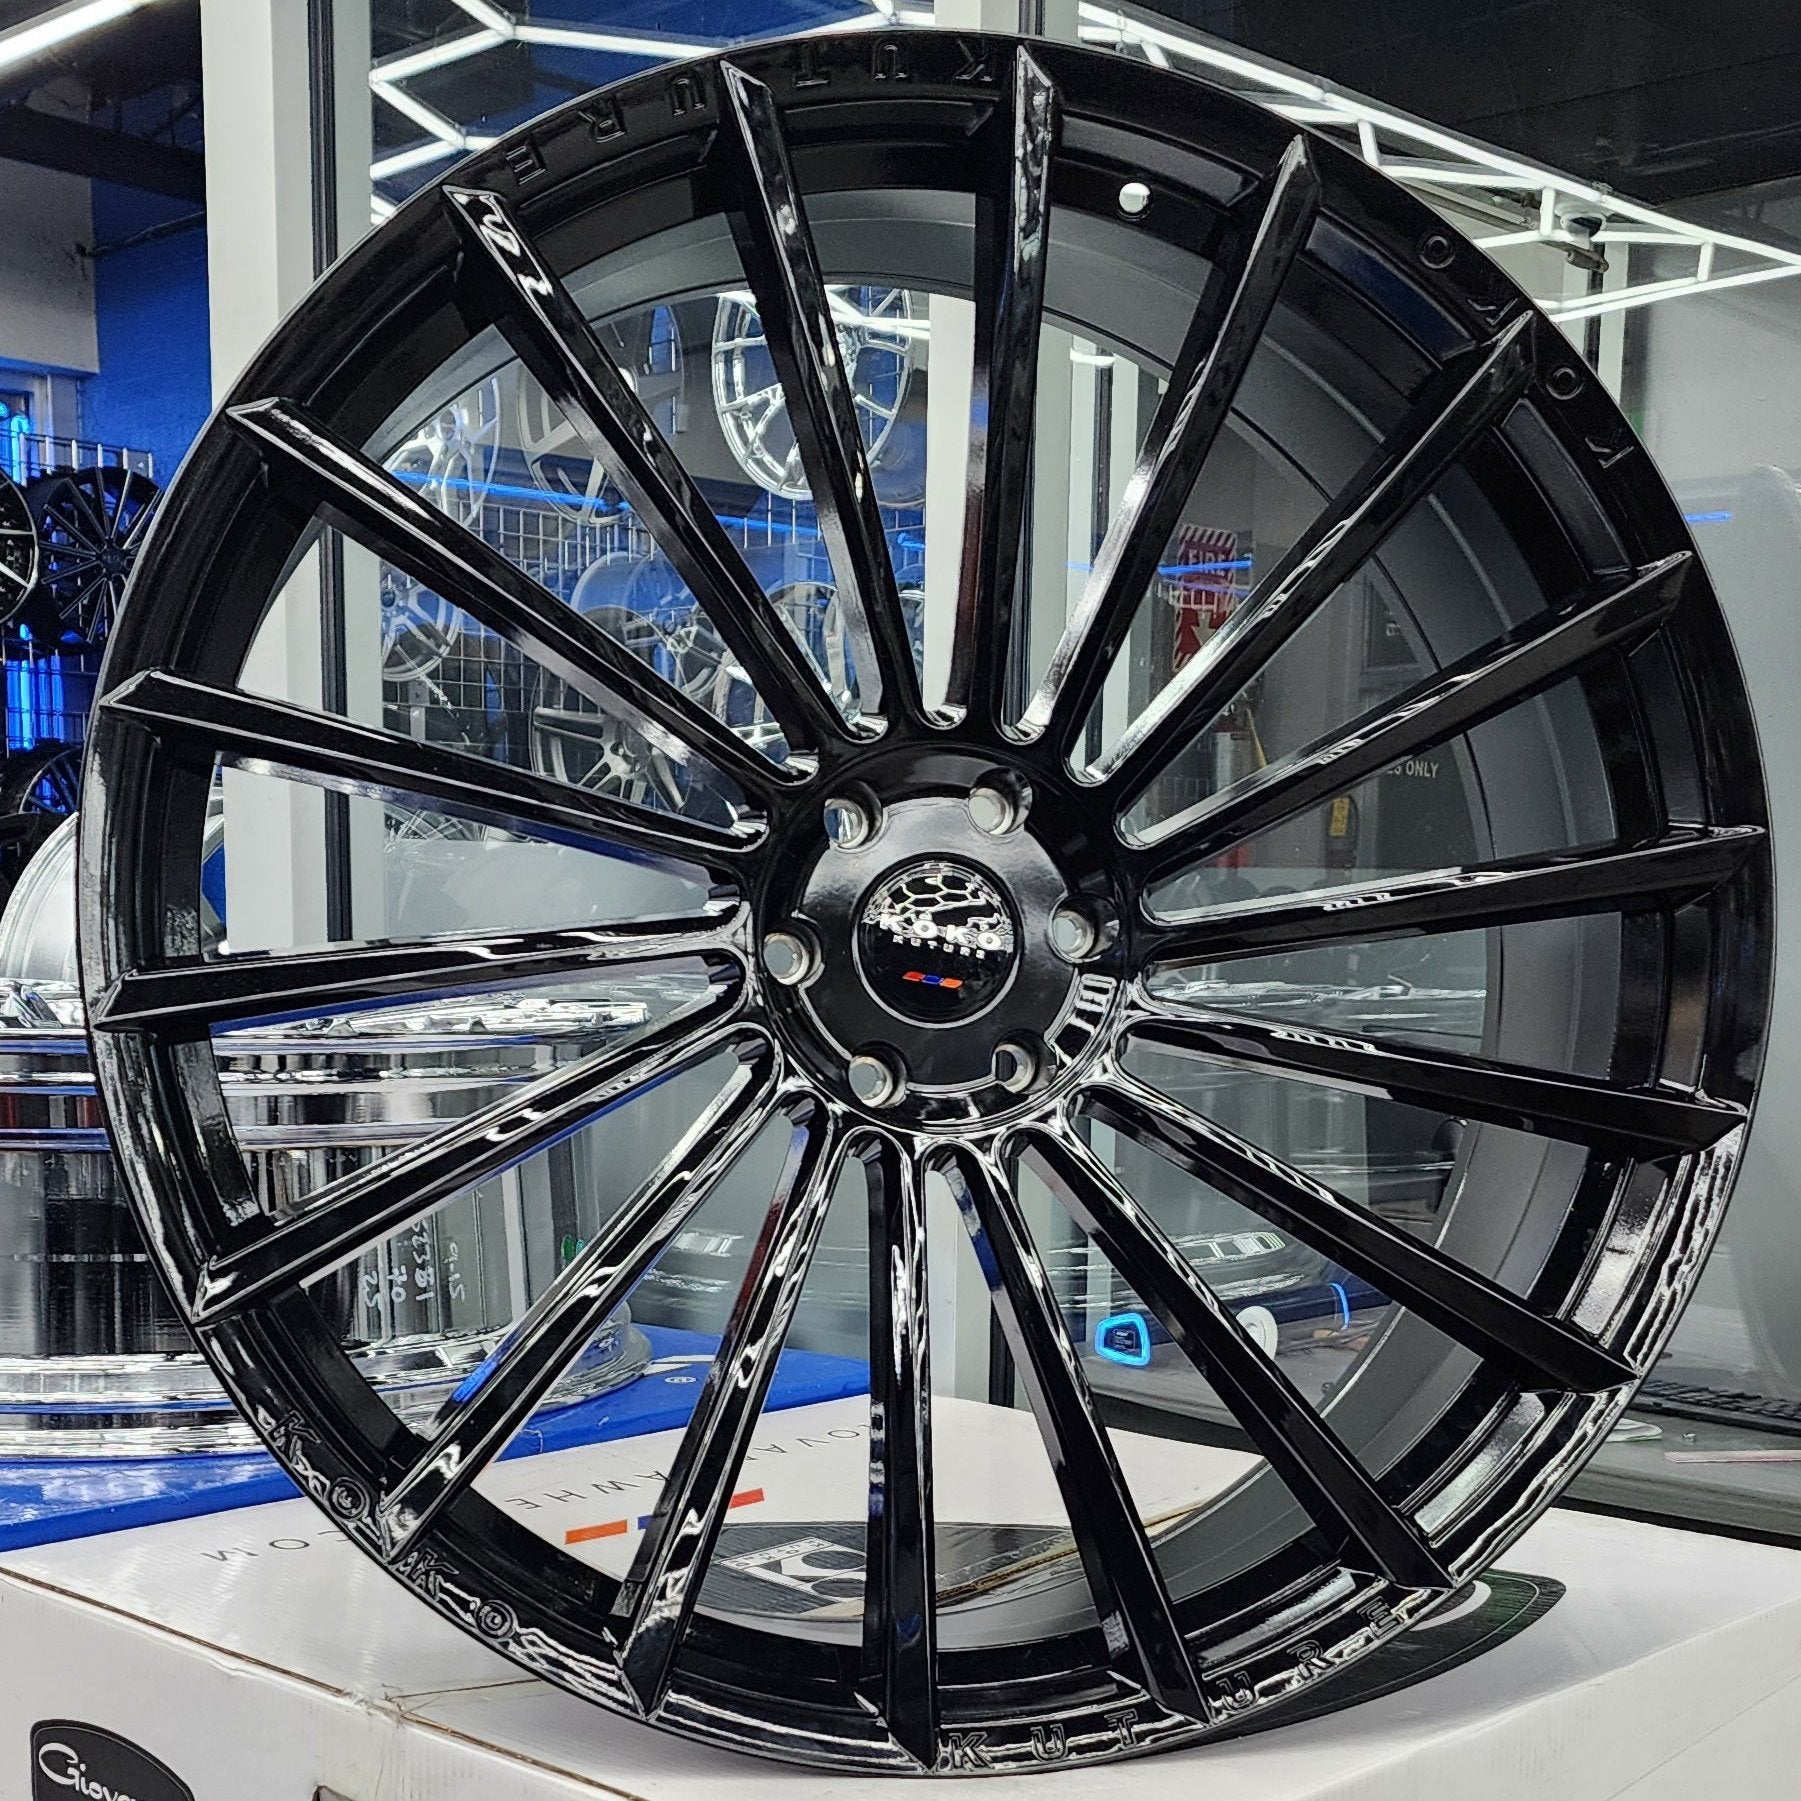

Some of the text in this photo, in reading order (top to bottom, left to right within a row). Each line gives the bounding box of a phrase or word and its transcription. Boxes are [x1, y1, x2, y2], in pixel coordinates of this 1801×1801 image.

[504, 38, 994, 185] KUTURE
[1406, 760, 1439, 779] ONLY
[268, 1409, 1402, 1769] KOKO KUTURE
